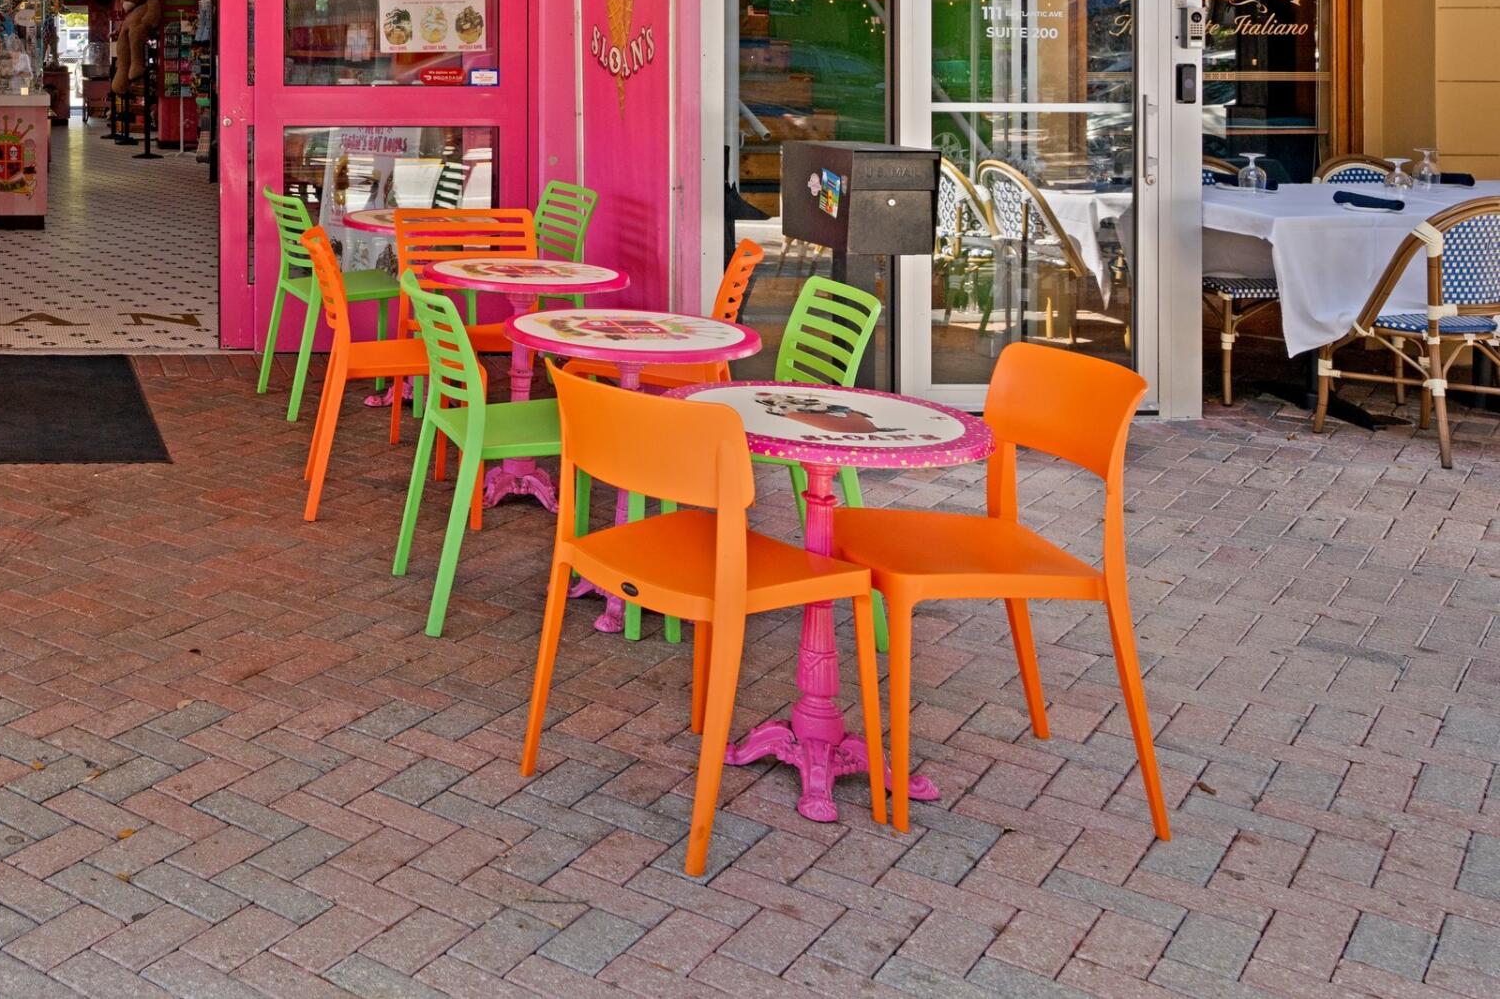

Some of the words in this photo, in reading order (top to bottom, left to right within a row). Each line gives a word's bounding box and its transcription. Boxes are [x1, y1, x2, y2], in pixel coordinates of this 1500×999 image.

[981, 5, 1002, 20] 111
[985, 26, 1028, 38] SUITE
[1032, 27, 1059, 40] 200
[1226, 12, 1310, 37] Italiano
[591, 24, 655, 78] SLOAN'S
